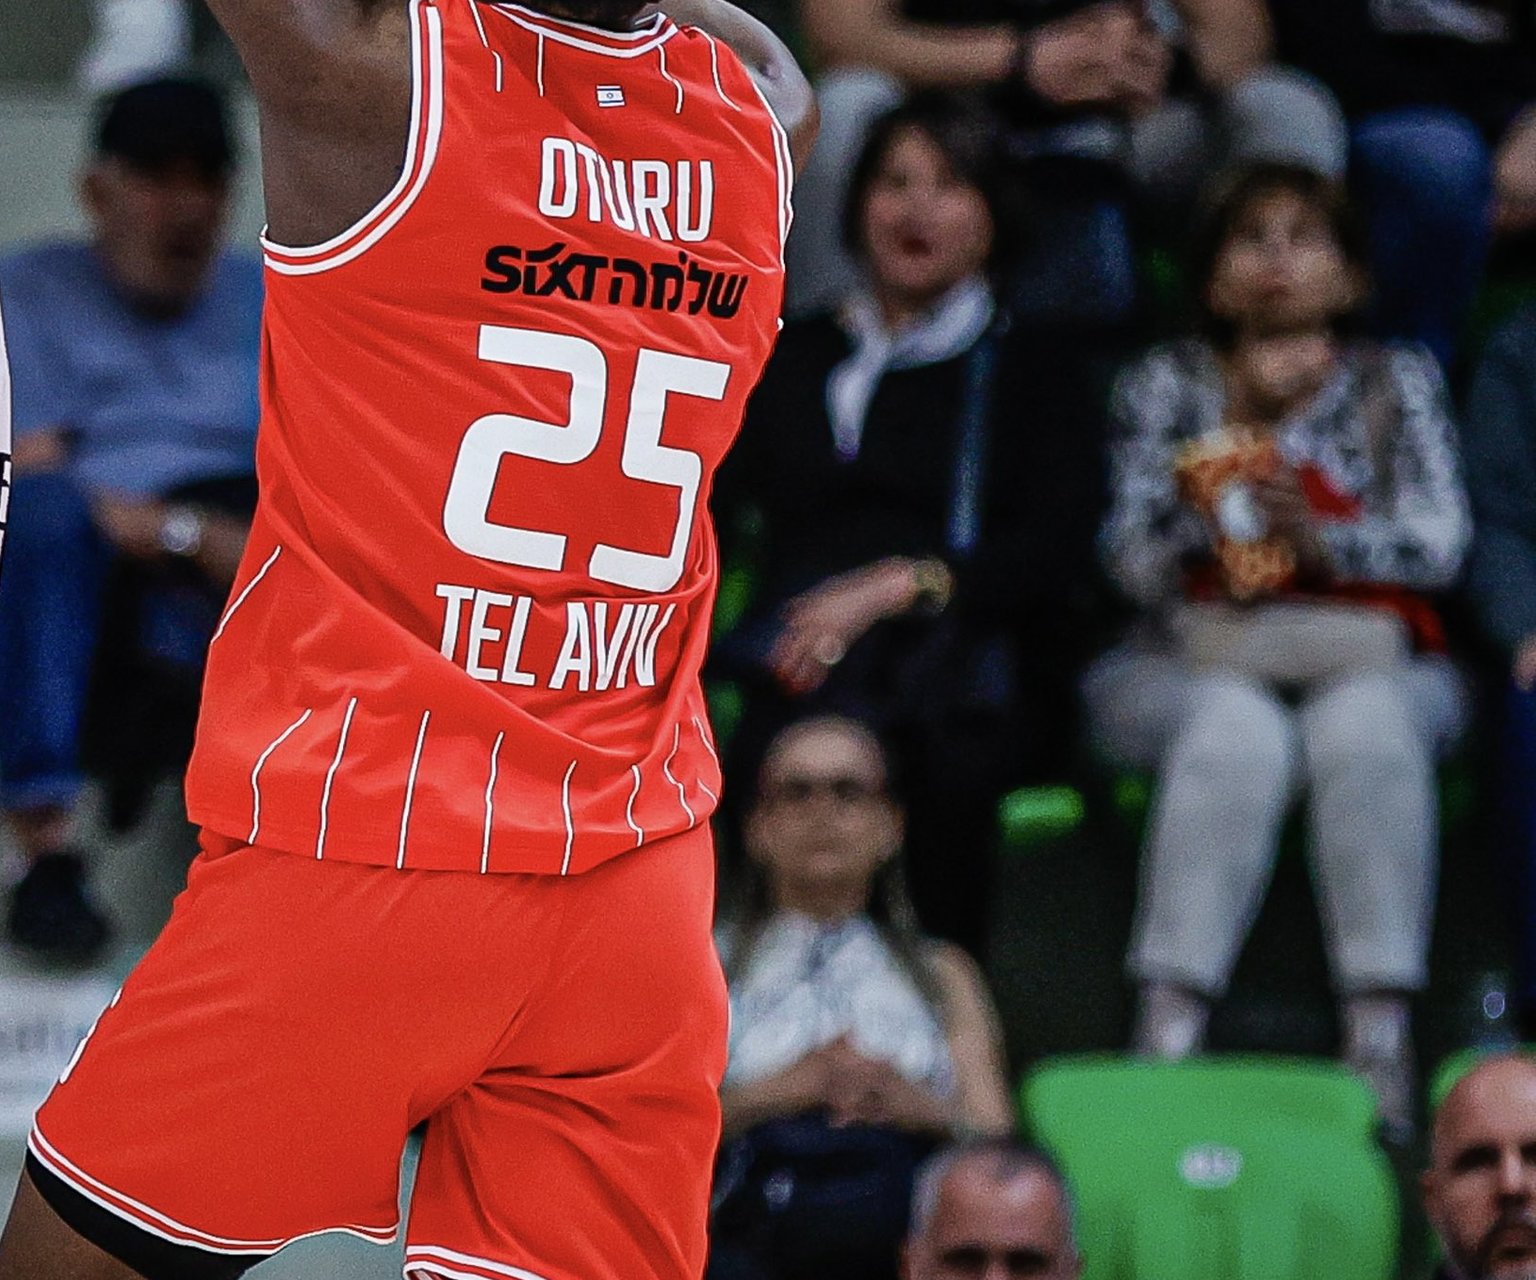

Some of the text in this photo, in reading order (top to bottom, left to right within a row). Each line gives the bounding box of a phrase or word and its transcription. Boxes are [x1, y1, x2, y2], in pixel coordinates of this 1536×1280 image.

[538, 137, 714, 242] OTURU
[443, 323, 732, 594] 25
[435, 583, 677, 692] TEL AVIV
